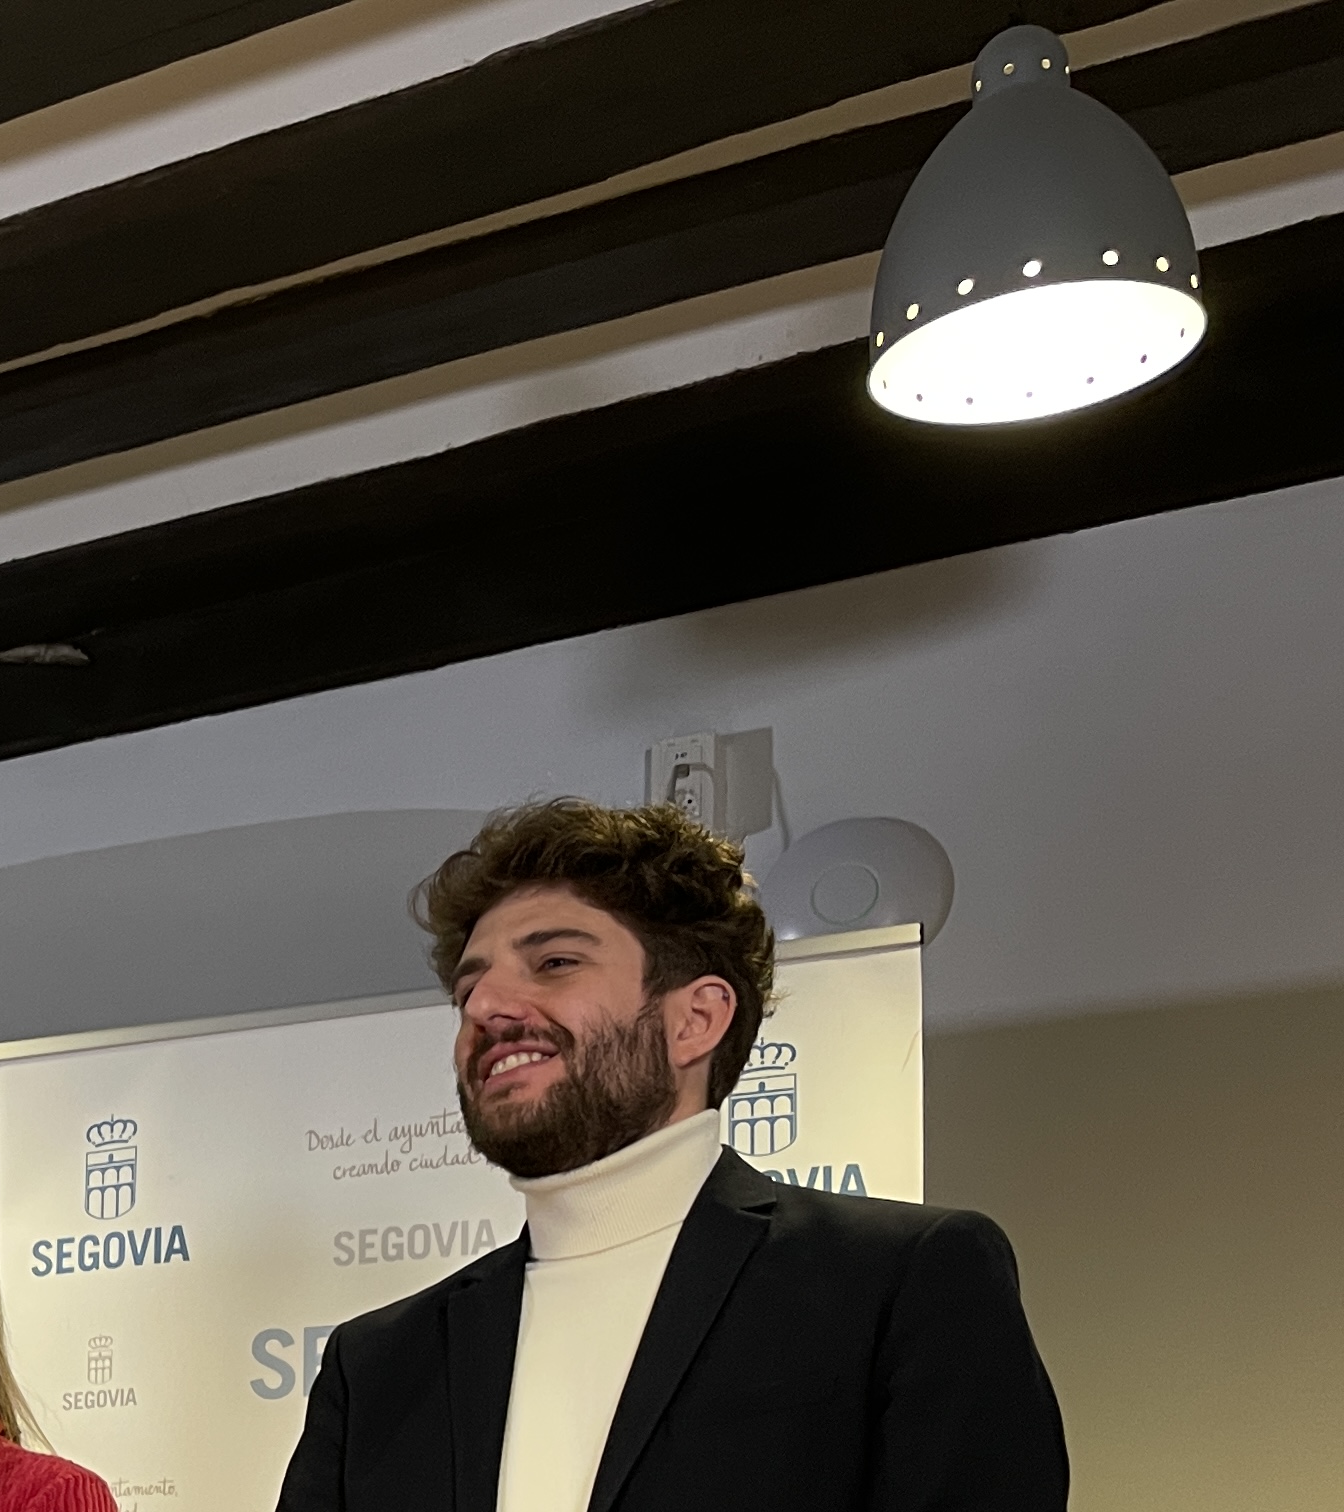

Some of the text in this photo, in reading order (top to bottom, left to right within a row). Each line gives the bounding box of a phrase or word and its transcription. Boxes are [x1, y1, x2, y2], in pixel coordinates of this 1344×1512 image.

[388, 1108, 463, 1154] ayunta
[333, 1149, 401, 1180] creando
[31, 1225, 191, 1278] SEGOVIA
[333, 1219, 497, 1267] SEGOVIA
[62, 1387, 137, 1412] SEGOVIA
